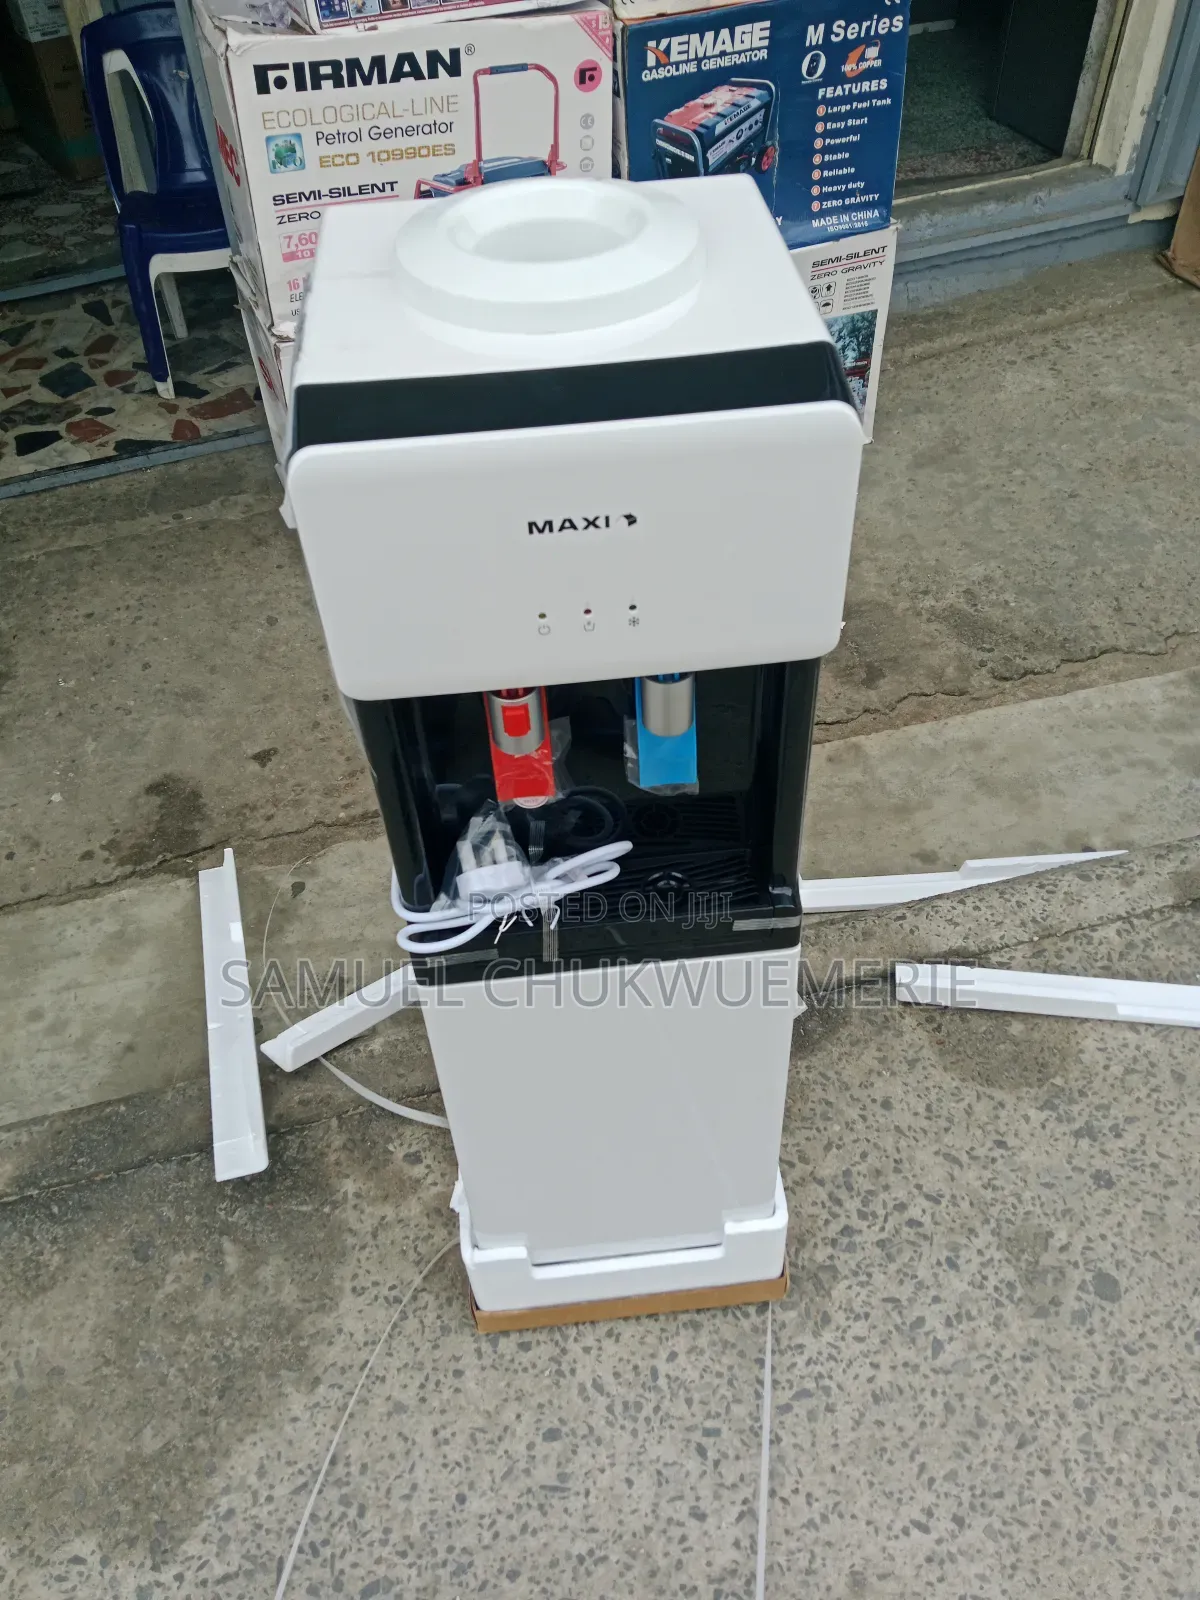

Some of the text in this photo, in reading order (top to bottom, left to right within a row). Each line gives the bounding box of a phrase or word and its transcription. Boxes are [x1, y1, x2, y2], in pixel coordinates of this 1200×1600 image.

[805, 13, 904, 47] M Series
[642, 20, 771, 68] KEMAGE
[641, 48, 768, 82] GASOLINE GENERATOR
[858, 58, 882, 69] COPPER
[817, 78, 888, 100] FEATURES
[261, 94, 460, 131] ECOLOGICAL-LINE
[827, 104, 851, 114] Large
[852, 100, 870, 110] Fuel
[871, 97, 892, 107] Tank
[315, 120, 455, 147] Petrol Generator
[826, 121, 846, 130] Easy
[847, 117, 868, 127] Start
[825, 134, 861, 146] Powerful
[318, 152, 360, 169] ECO
[366, 143, 457, 164] 10990ES
[823, 152, 850, 162] Stable
[822, 167, 856, 178] Reliable
[272, 181, 399, 207] SEMI-SILENT
[822, 185, 847, 193] Heavy
[847, 181, 865, 189] duty
[822, 200, 843, 209] ZERO
[844, 193, 880, 205] GRAVITY
[275, 210, 322, 226] ZERO
[811, 208, 880, 228] MADE IN CHINA
[811, 245, 888, 269] SEMI-SILENT
[809, 260, 886, 282] ZERO GRAVITY
[527, 515, 610, 535] MAXI
